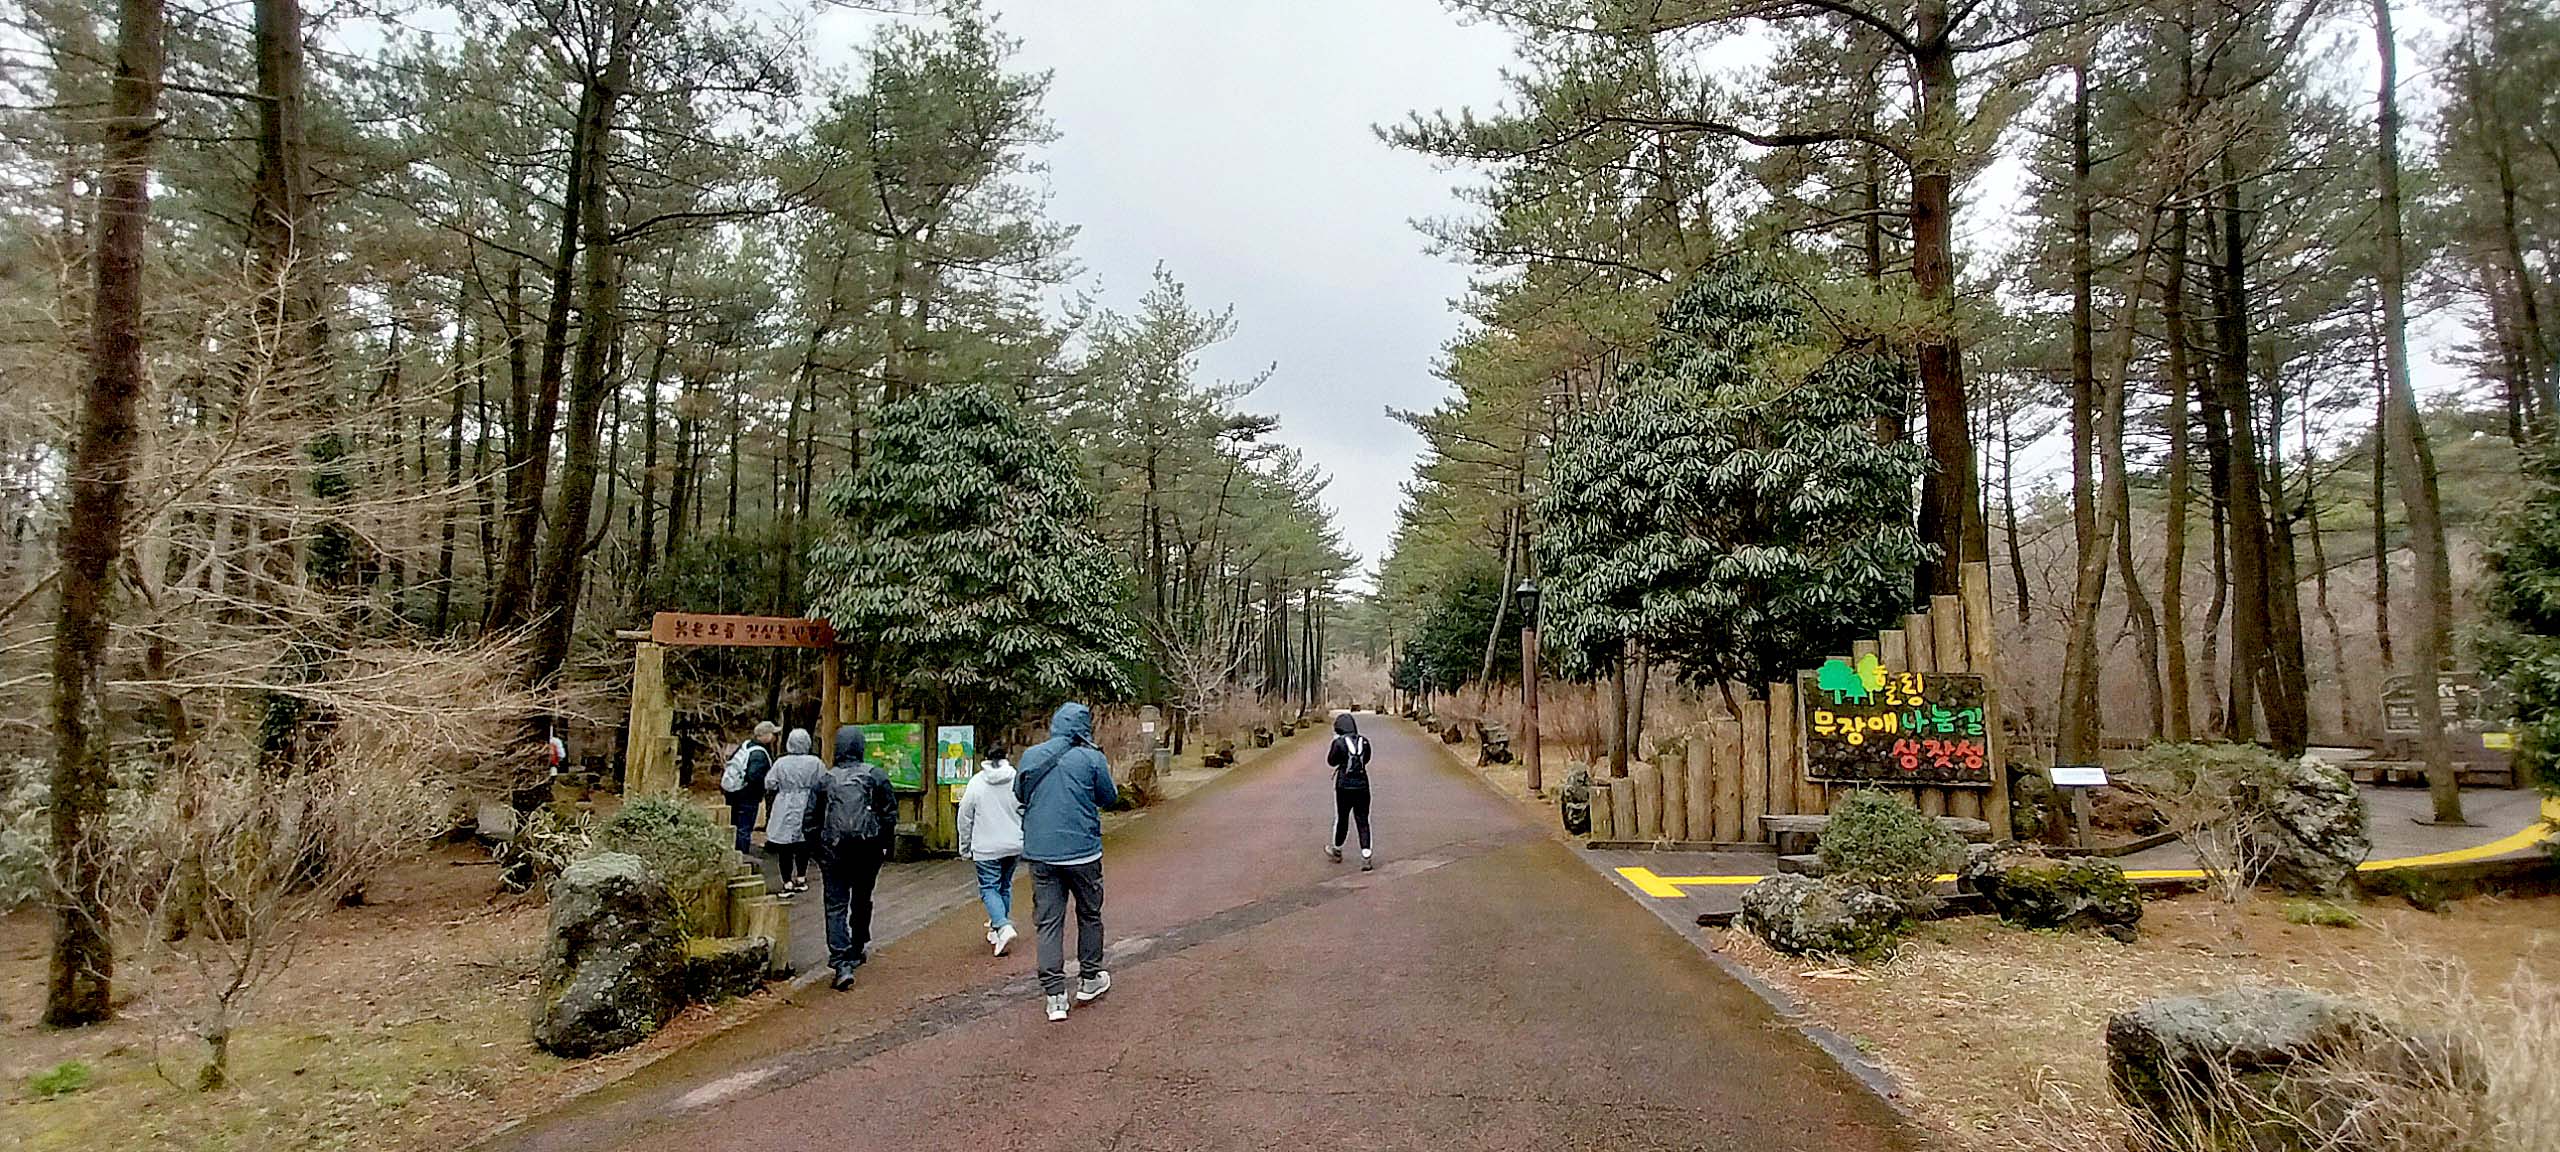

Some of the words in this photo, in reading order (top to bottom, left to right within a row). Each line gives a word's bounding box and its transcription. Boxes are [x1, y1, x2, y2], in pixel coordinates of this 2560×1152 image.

[674, 619, 735, 640] 붉은오름
[1814, 711, 1898, 746] 무장애
[1902, 704, 1984, 736] 나눔길
[1893, 739, 1985, 769] 상잣성
